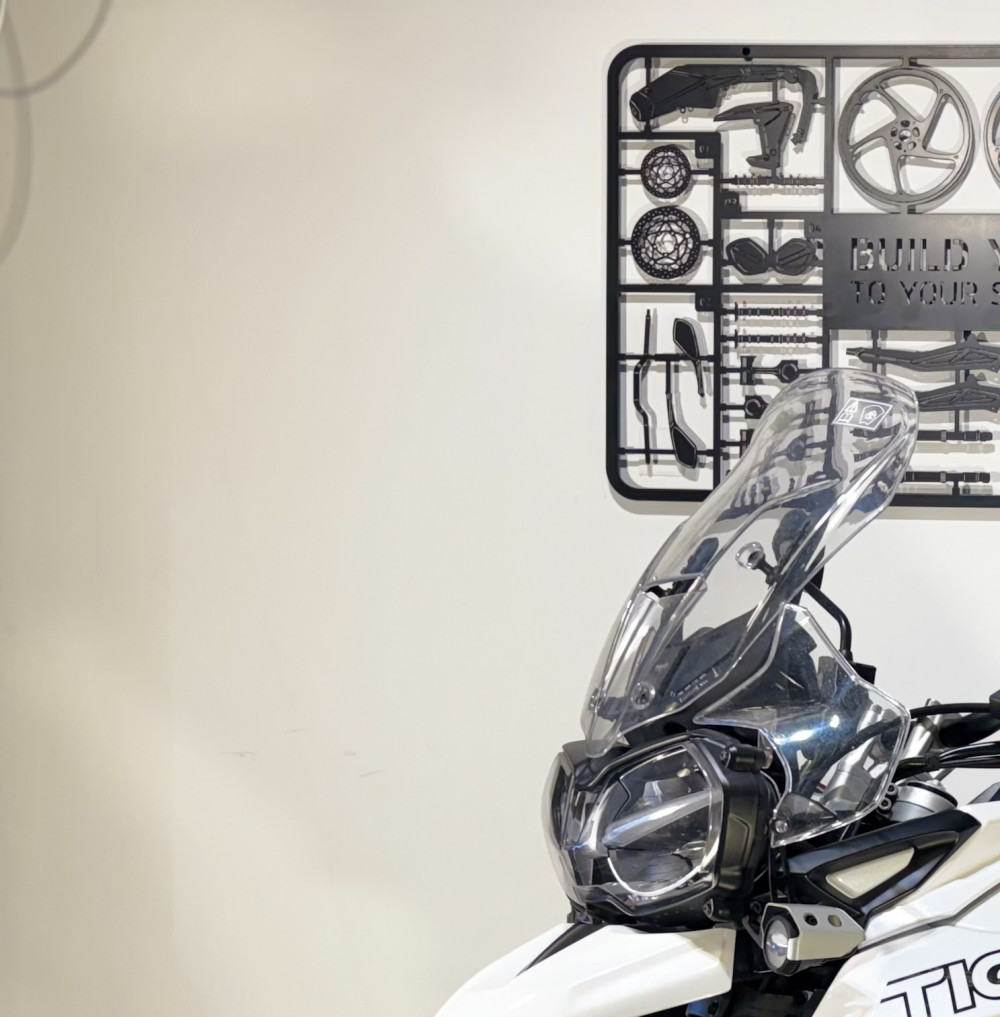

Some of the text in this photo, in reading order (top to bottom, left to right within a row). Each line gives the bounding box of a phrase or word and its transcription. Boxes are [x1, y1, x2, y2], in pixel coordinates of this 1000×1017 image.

[851, 237, 969, 272] BUILD
[850, 280, 886, 305] TO
[899, 280, 978, 305] YOUR
